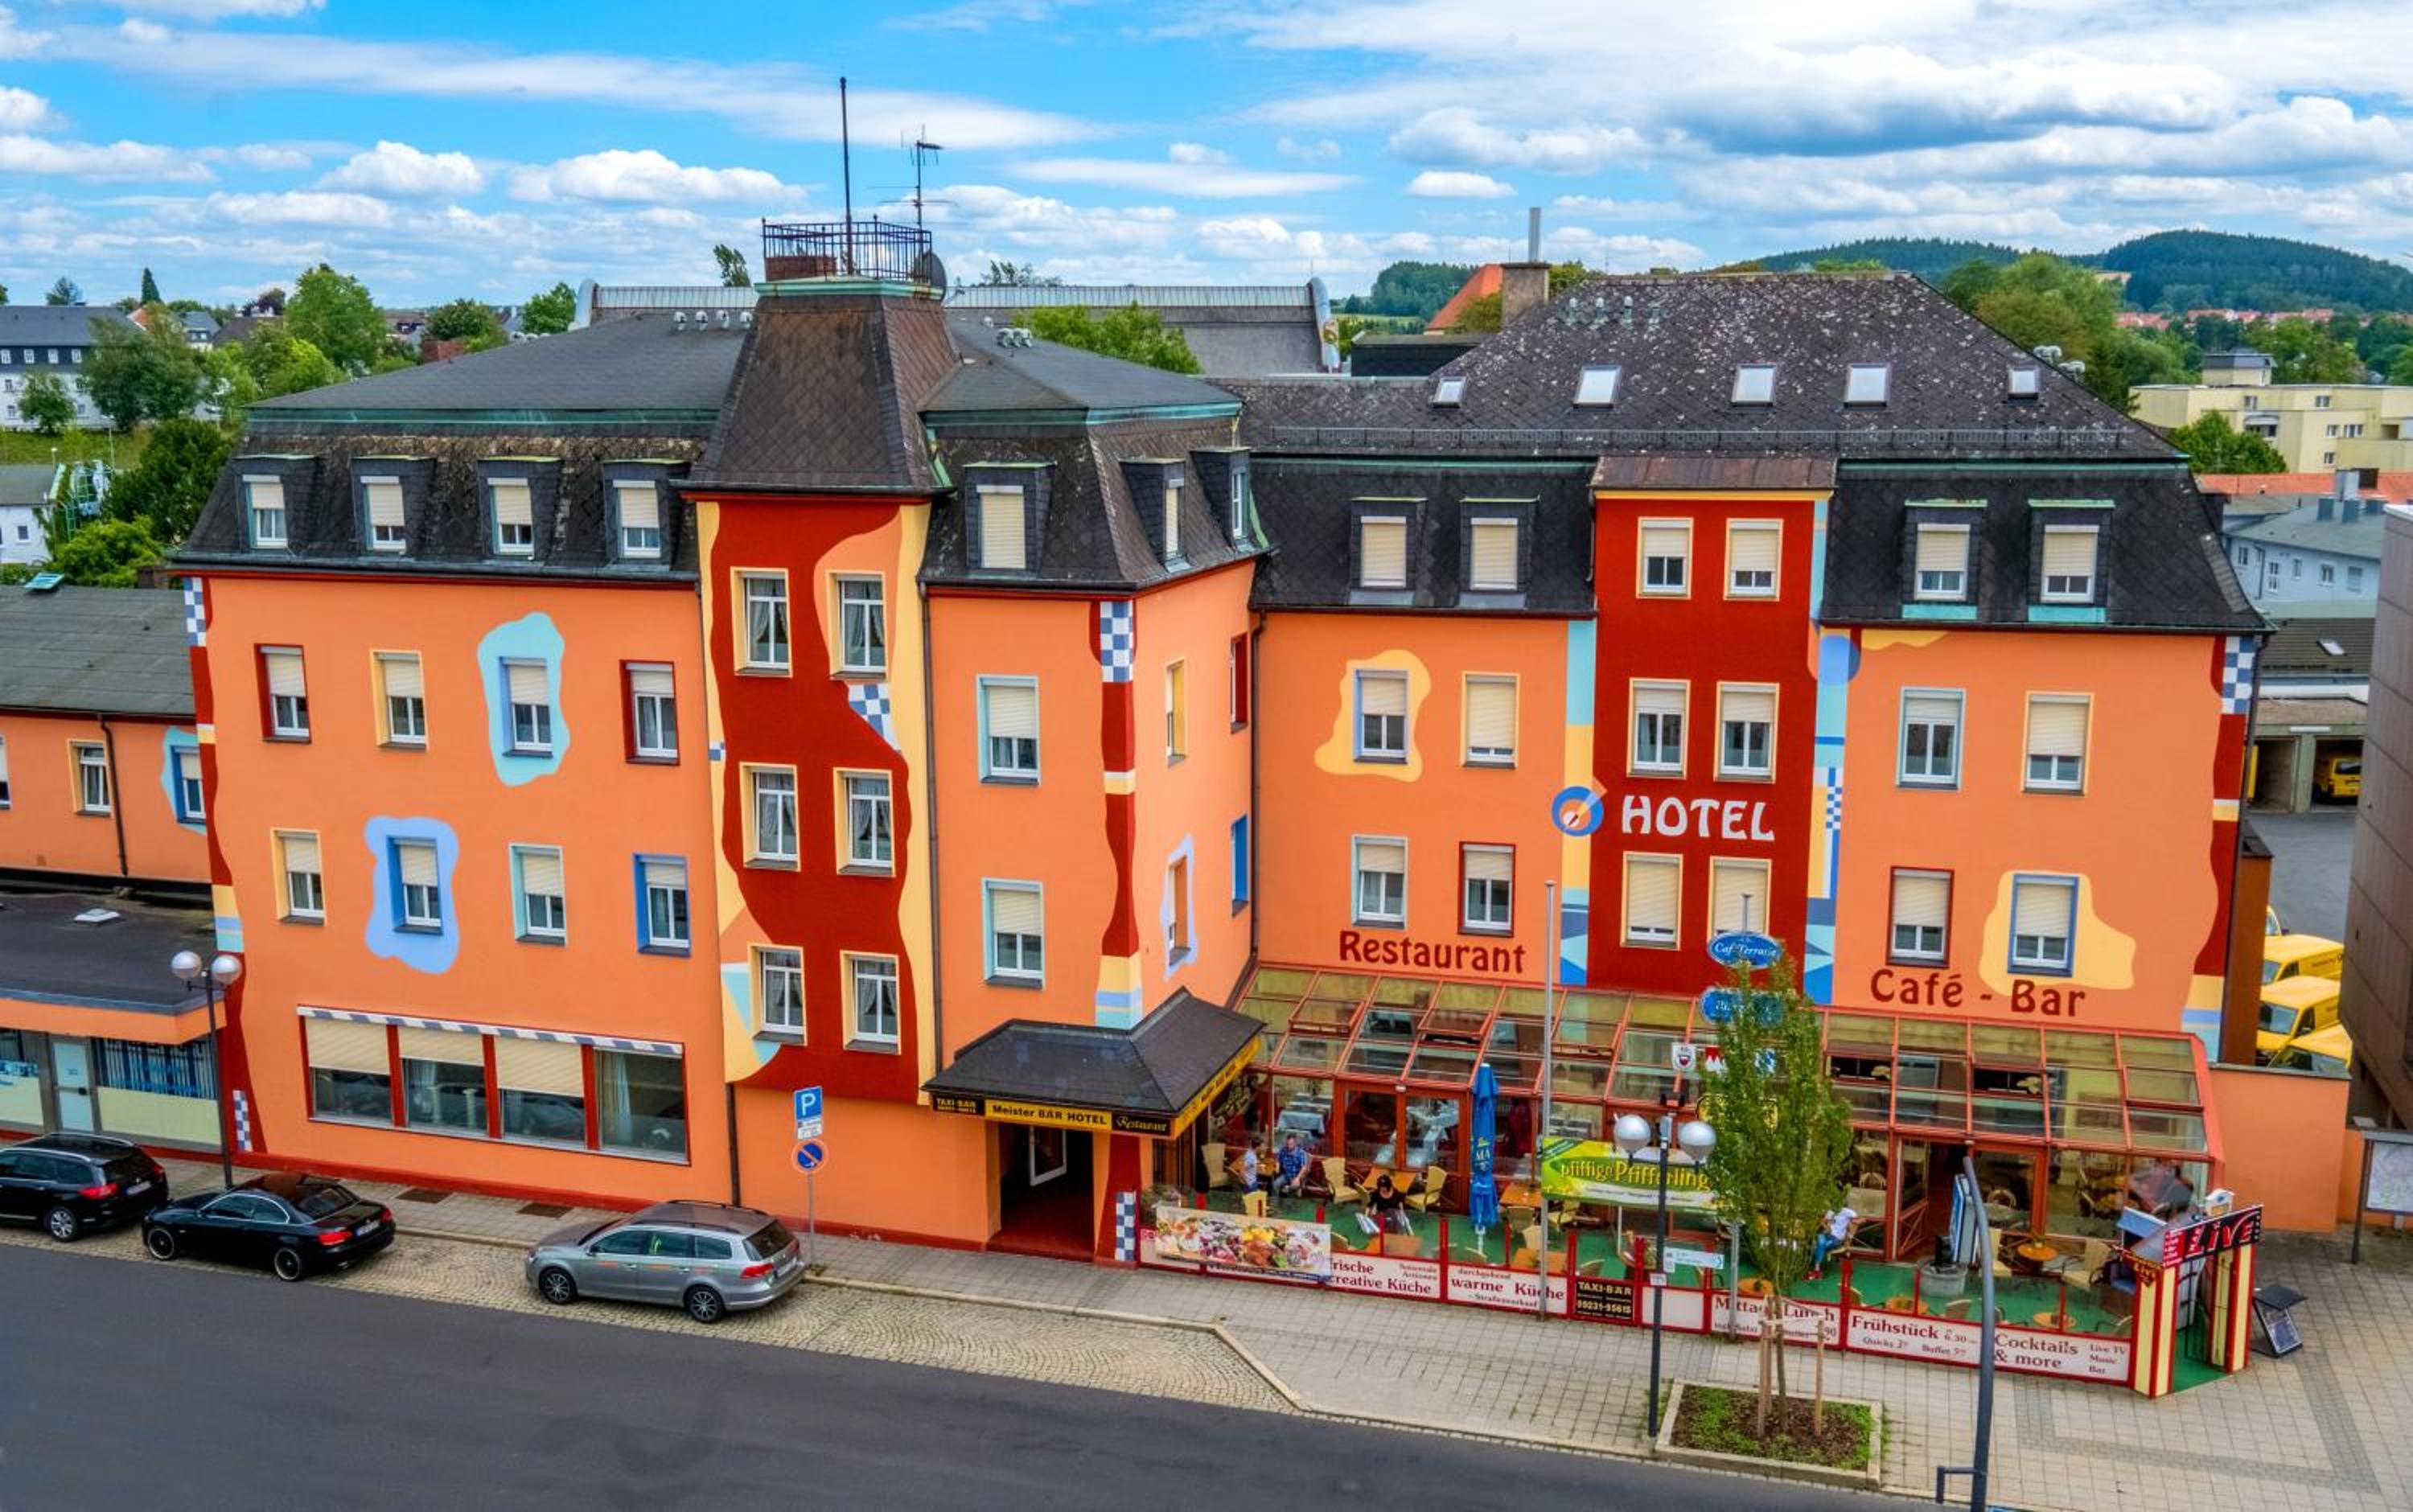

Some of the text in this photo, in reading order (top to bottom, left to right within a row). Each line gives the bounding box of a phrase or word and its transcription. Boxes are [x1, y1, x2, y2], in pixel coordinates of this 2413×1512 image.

[1622, 794, 1775, 842] HOTEL
[1339, 931, 1526, 973] Restaurant
[1870, 968, 1963, 1008] Café
[2011, 979, 2086, 1017] Bar
[801, 1093, 816, 1116] P
[992, 1104, 1034, 1117] Meister
[1067, 1112, 1107, 1125] HOTEL
[1332, 1259, 1374, 1274] rische
[1335, 1275, 1432, 1294] reative Küche
[1451, 1277, 1503, 1292] warme
[1852, 1316, 1938, 1339] Frühstück
[1995, 1333, 2078, 1355] Cocktails
[2015, 1354, 2062, 1368] more
